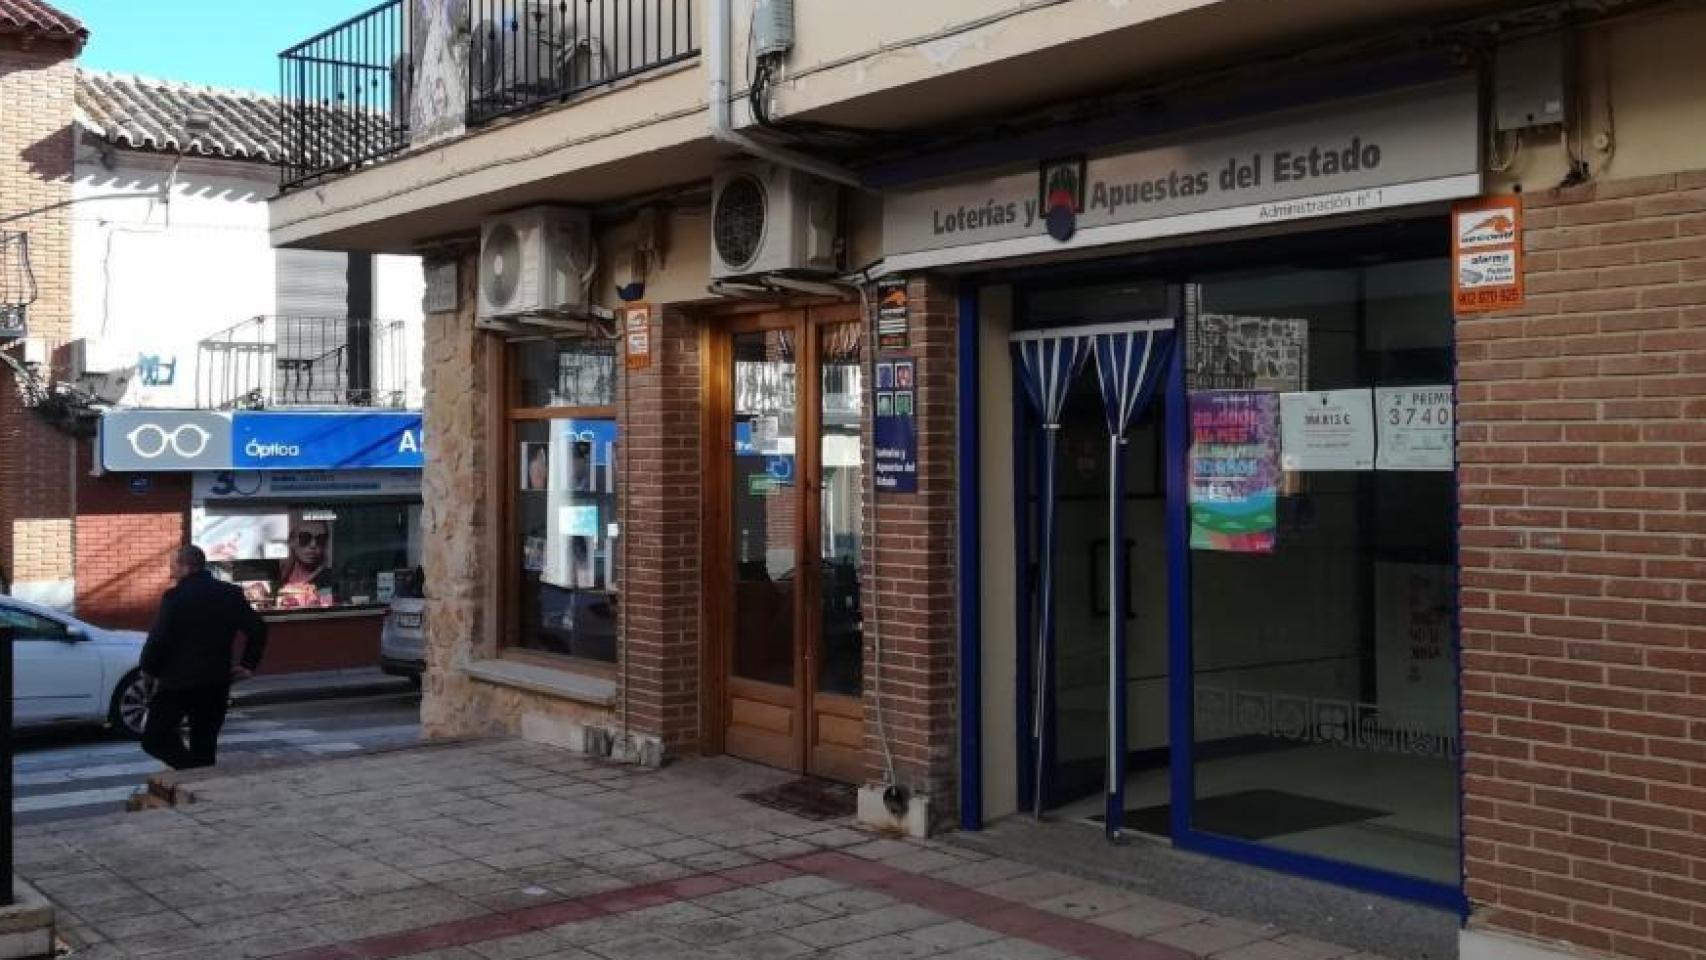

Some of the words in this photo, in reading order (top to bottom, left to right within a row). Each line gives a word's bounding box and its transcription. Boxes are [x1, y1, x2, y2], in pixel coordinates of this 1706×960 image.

[932, 197, 1017, 235] Loterías
[1023, 200, 1037, 228] y
[1090, 168, 1210, 215] Apuestas
[1219, 153, 1262, 189] del
[1272, 137, 1383, 184] Estado
[1260, 194, 1352, 218] Administración
[246, 438, 300, 458] Óptica
